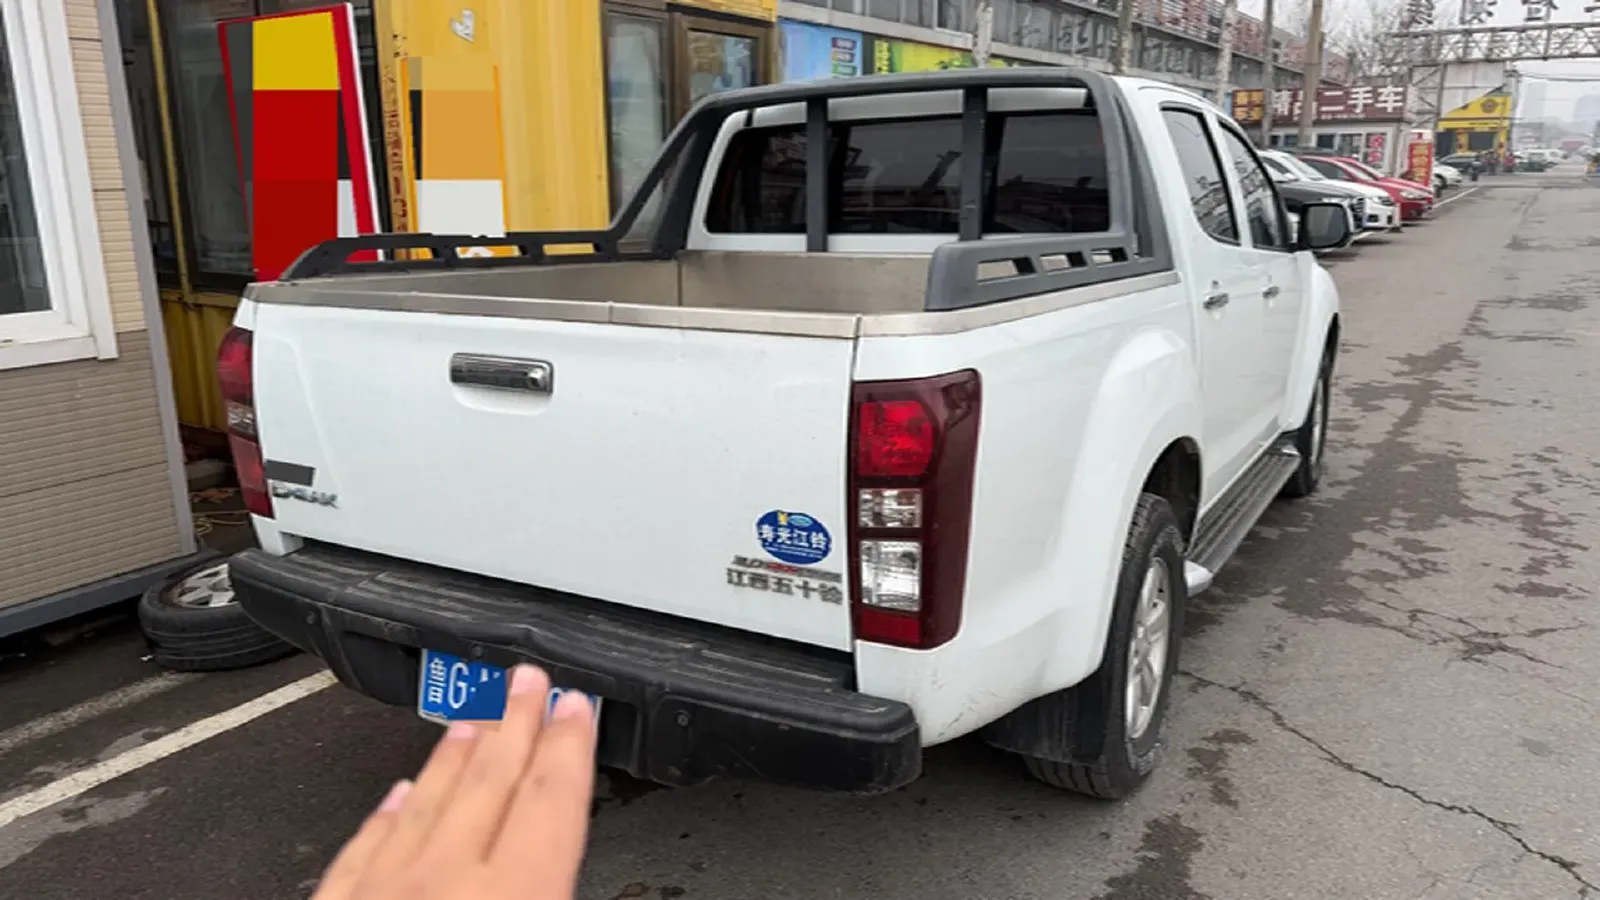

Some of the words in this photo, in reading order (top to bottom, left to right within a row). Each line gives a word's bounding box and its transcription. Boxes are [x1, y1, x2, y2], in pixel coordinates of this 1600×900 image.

[726, 567, 844, 606] 江西五十铃
